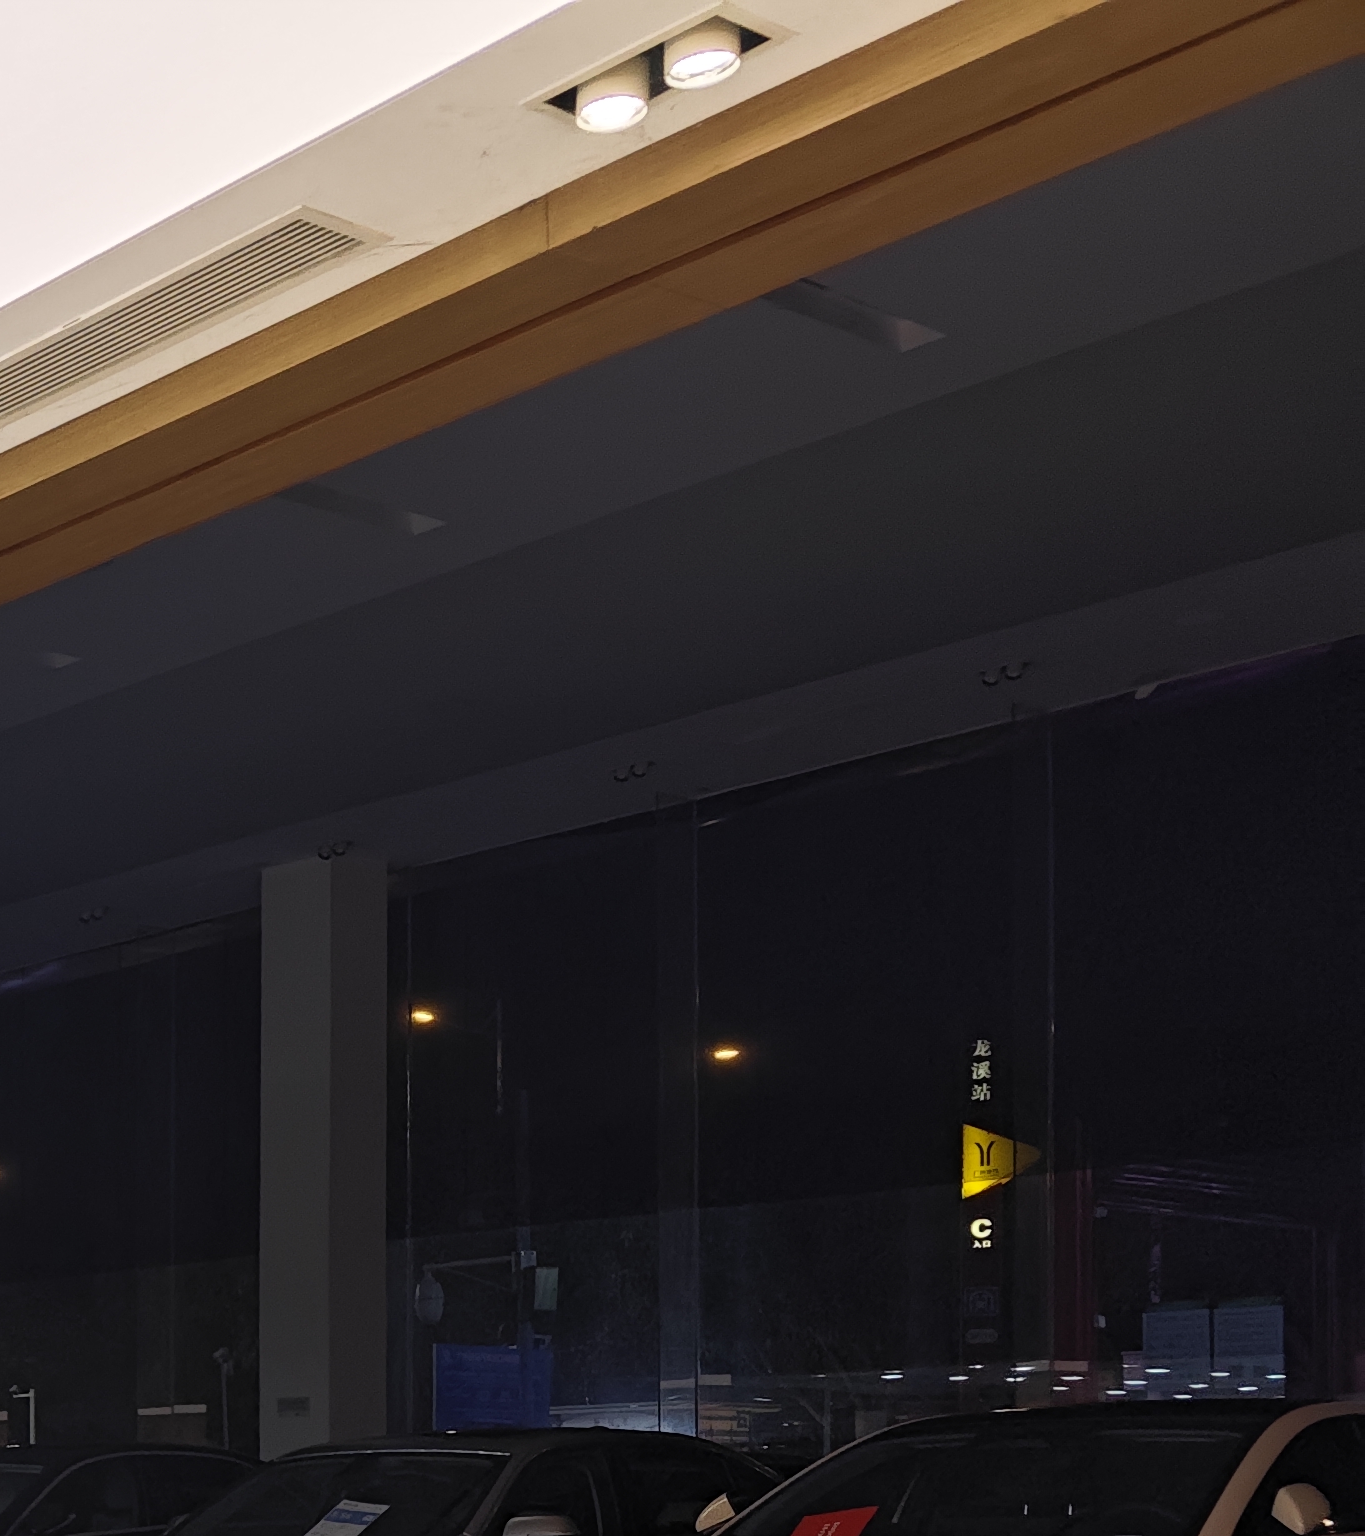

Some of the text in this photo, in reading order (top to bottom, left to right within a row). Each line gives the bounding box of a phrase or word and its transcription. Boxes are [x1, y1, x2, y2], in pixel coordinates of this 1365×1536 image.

[970, 1039, 992, 1102] 龙溪站
[970, 1218, 993, 1239] C
